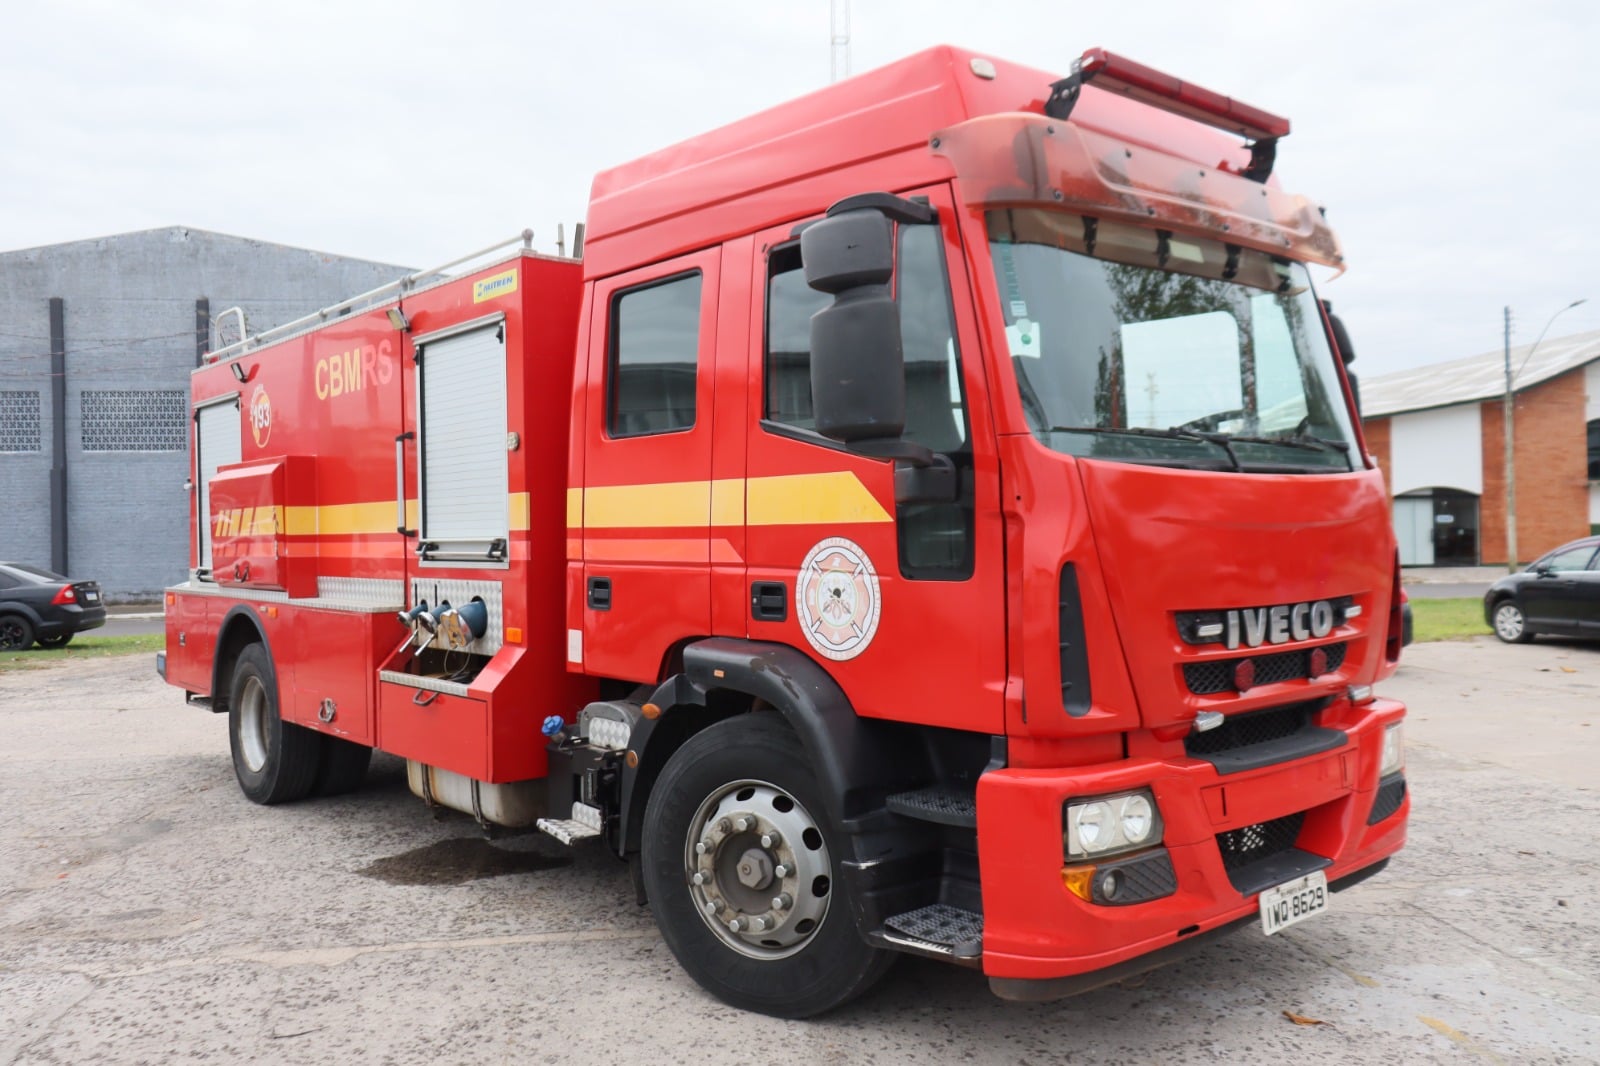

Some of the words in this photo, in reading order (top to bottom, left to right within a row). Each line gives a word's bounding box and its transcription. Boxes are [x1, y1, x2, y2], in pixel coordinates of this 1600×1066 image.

[315, 338, 393, 401] CBMRS
[254, 403, 271, 430] 193
[1227, 600, 1333, 650] IVECO
[1292, 886, 1325, 917] 8629
